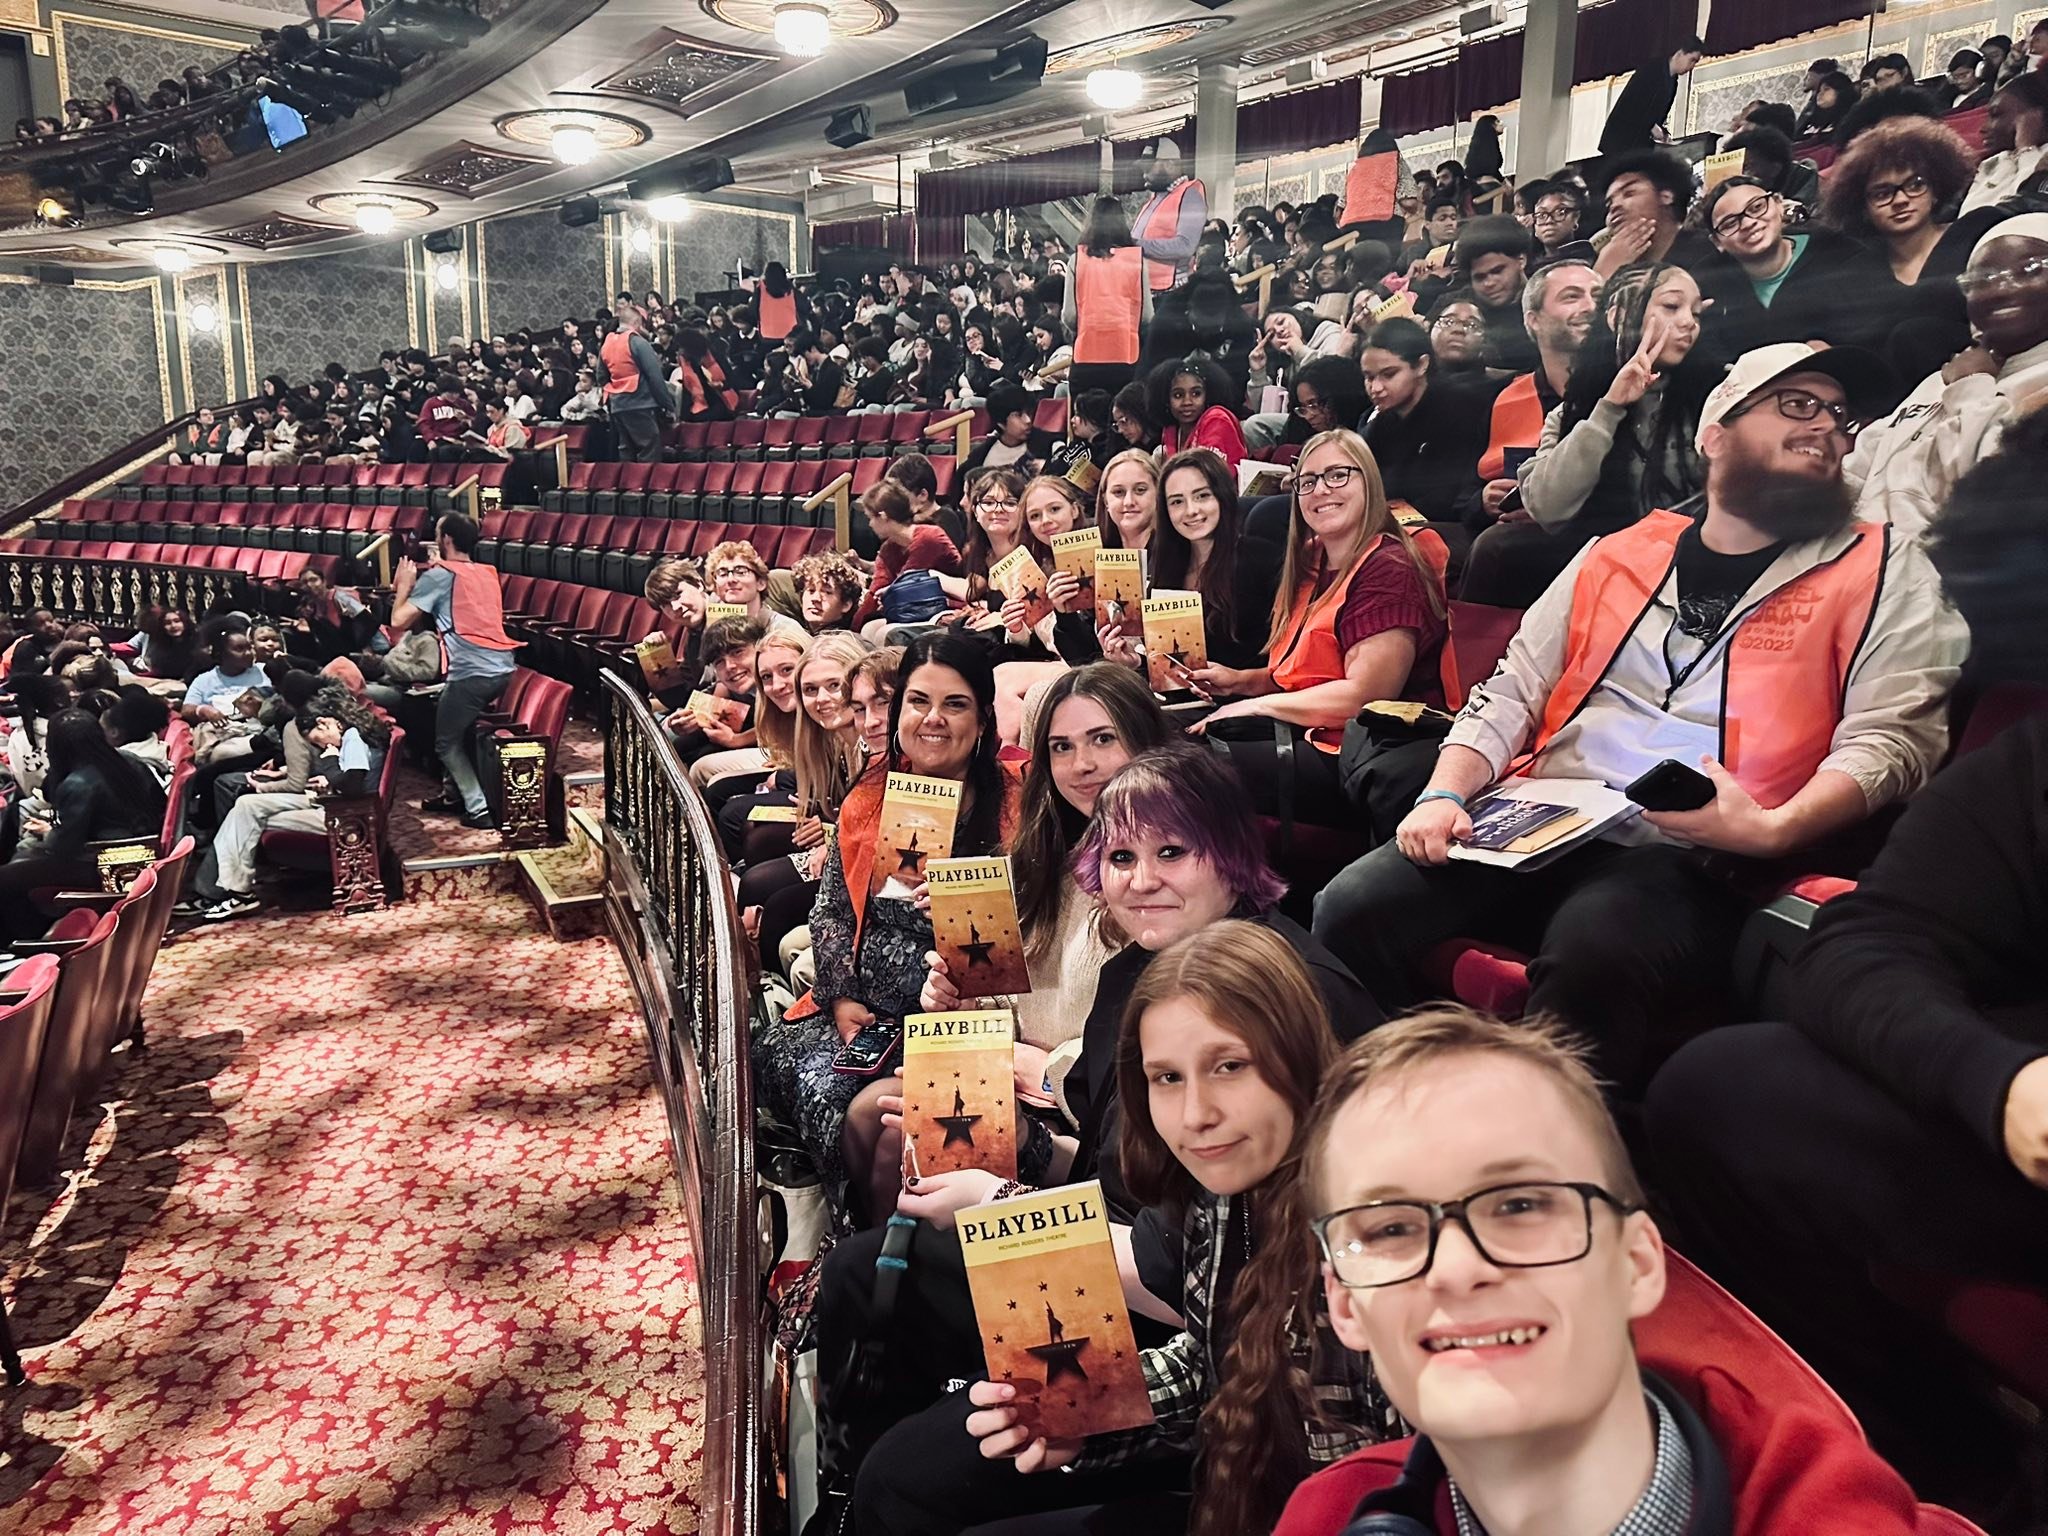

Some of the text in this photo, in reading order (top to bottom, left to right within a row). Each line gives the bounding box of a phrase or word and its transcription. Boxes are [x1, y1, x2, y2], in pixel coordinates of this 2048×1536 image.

[1053, 532, 1098, 547] PLAYBILL
[1096, 554, 1137, 562] PLAYBILL
[708, 606, 745, 614] PLAYBILL
[1144, 598, 1200, 613] PLAYBILL
[888, 779, 956, 798] PLAYBILL
[928, 866, 1003, 883] PLAYBILL
[907, 1019, 1006, 1038] PLAYBILL
[962, 1200, 1097, 1243] PLAYBILL
[1046, 1232, 1067, 1241] THEATRE
